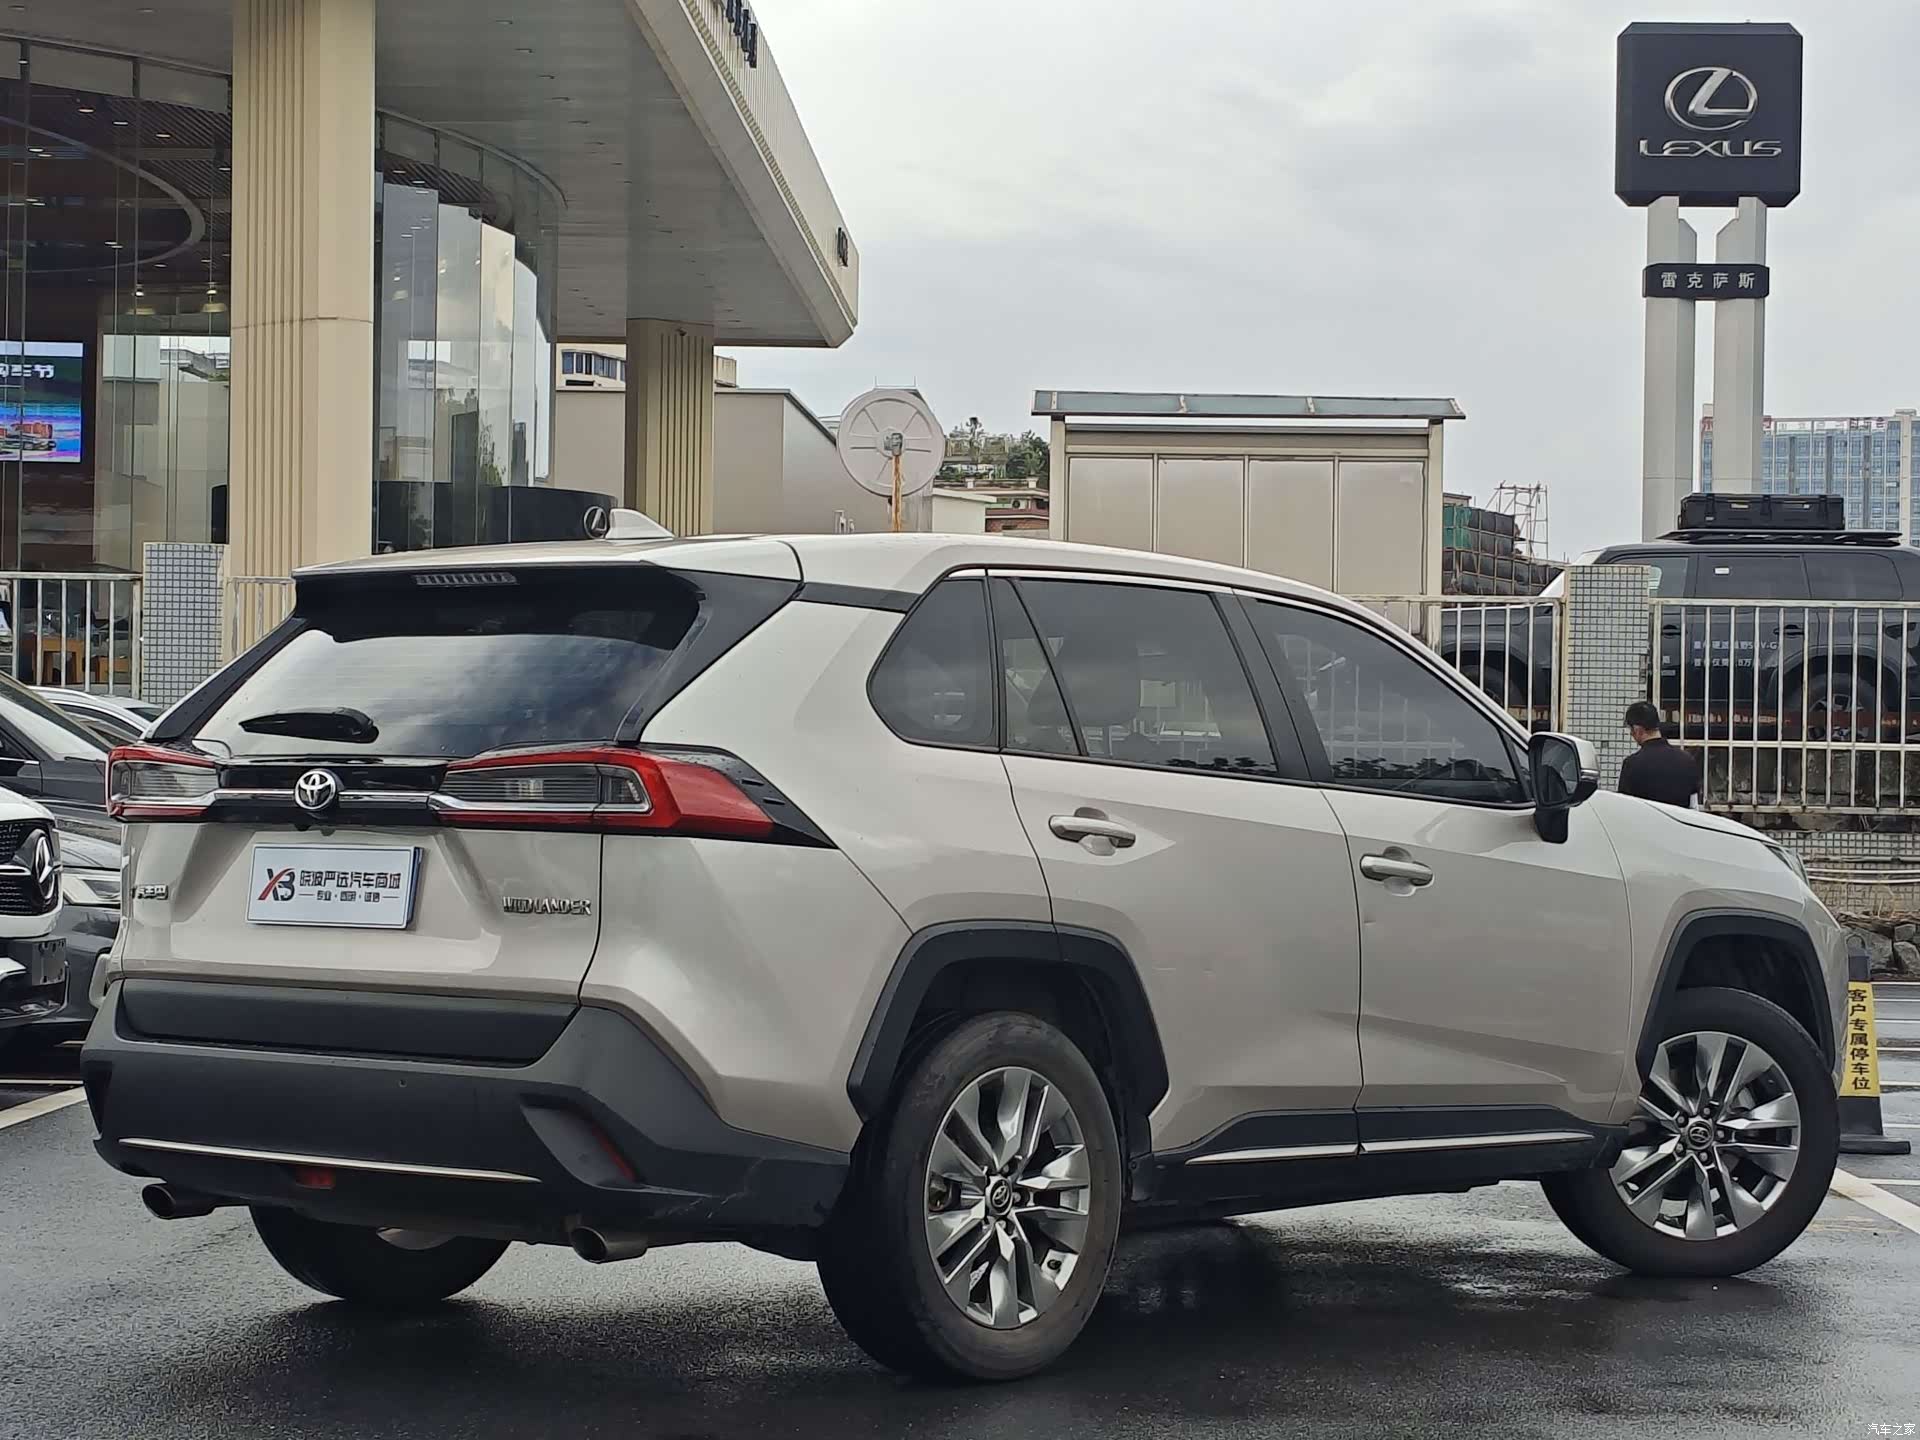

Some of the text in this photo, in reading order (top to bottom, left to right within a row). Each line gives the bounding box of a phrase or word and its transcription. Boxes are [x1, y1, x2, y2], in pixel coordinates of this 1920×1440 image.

[1639, 139, 1782, 157] LEXUS
[1661, 272, 1755, 289] 雷克萨斯
[1848, 988, 1871, 1090] 客户专属停车位
